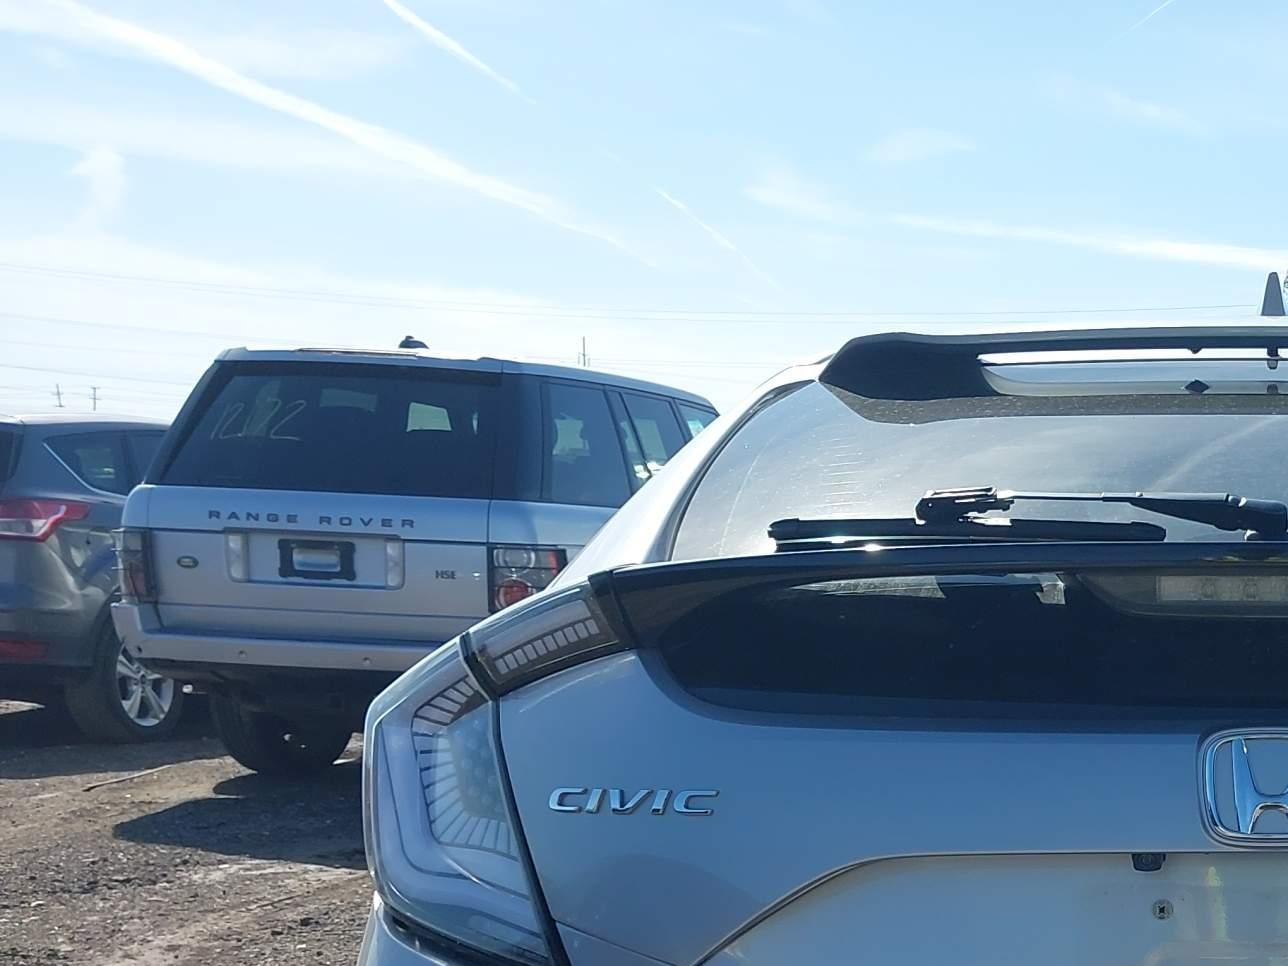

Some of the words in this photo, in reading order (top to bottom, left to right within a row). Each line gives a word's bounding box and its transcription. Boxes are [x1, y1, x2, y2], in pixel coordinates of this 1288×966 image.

[208, 510, 299, 524] RANGE
[319, 516, 415, 529] ROVER
[435, 570, 457, 580] HSE
[548, 787, 720, 817] CIVIC
